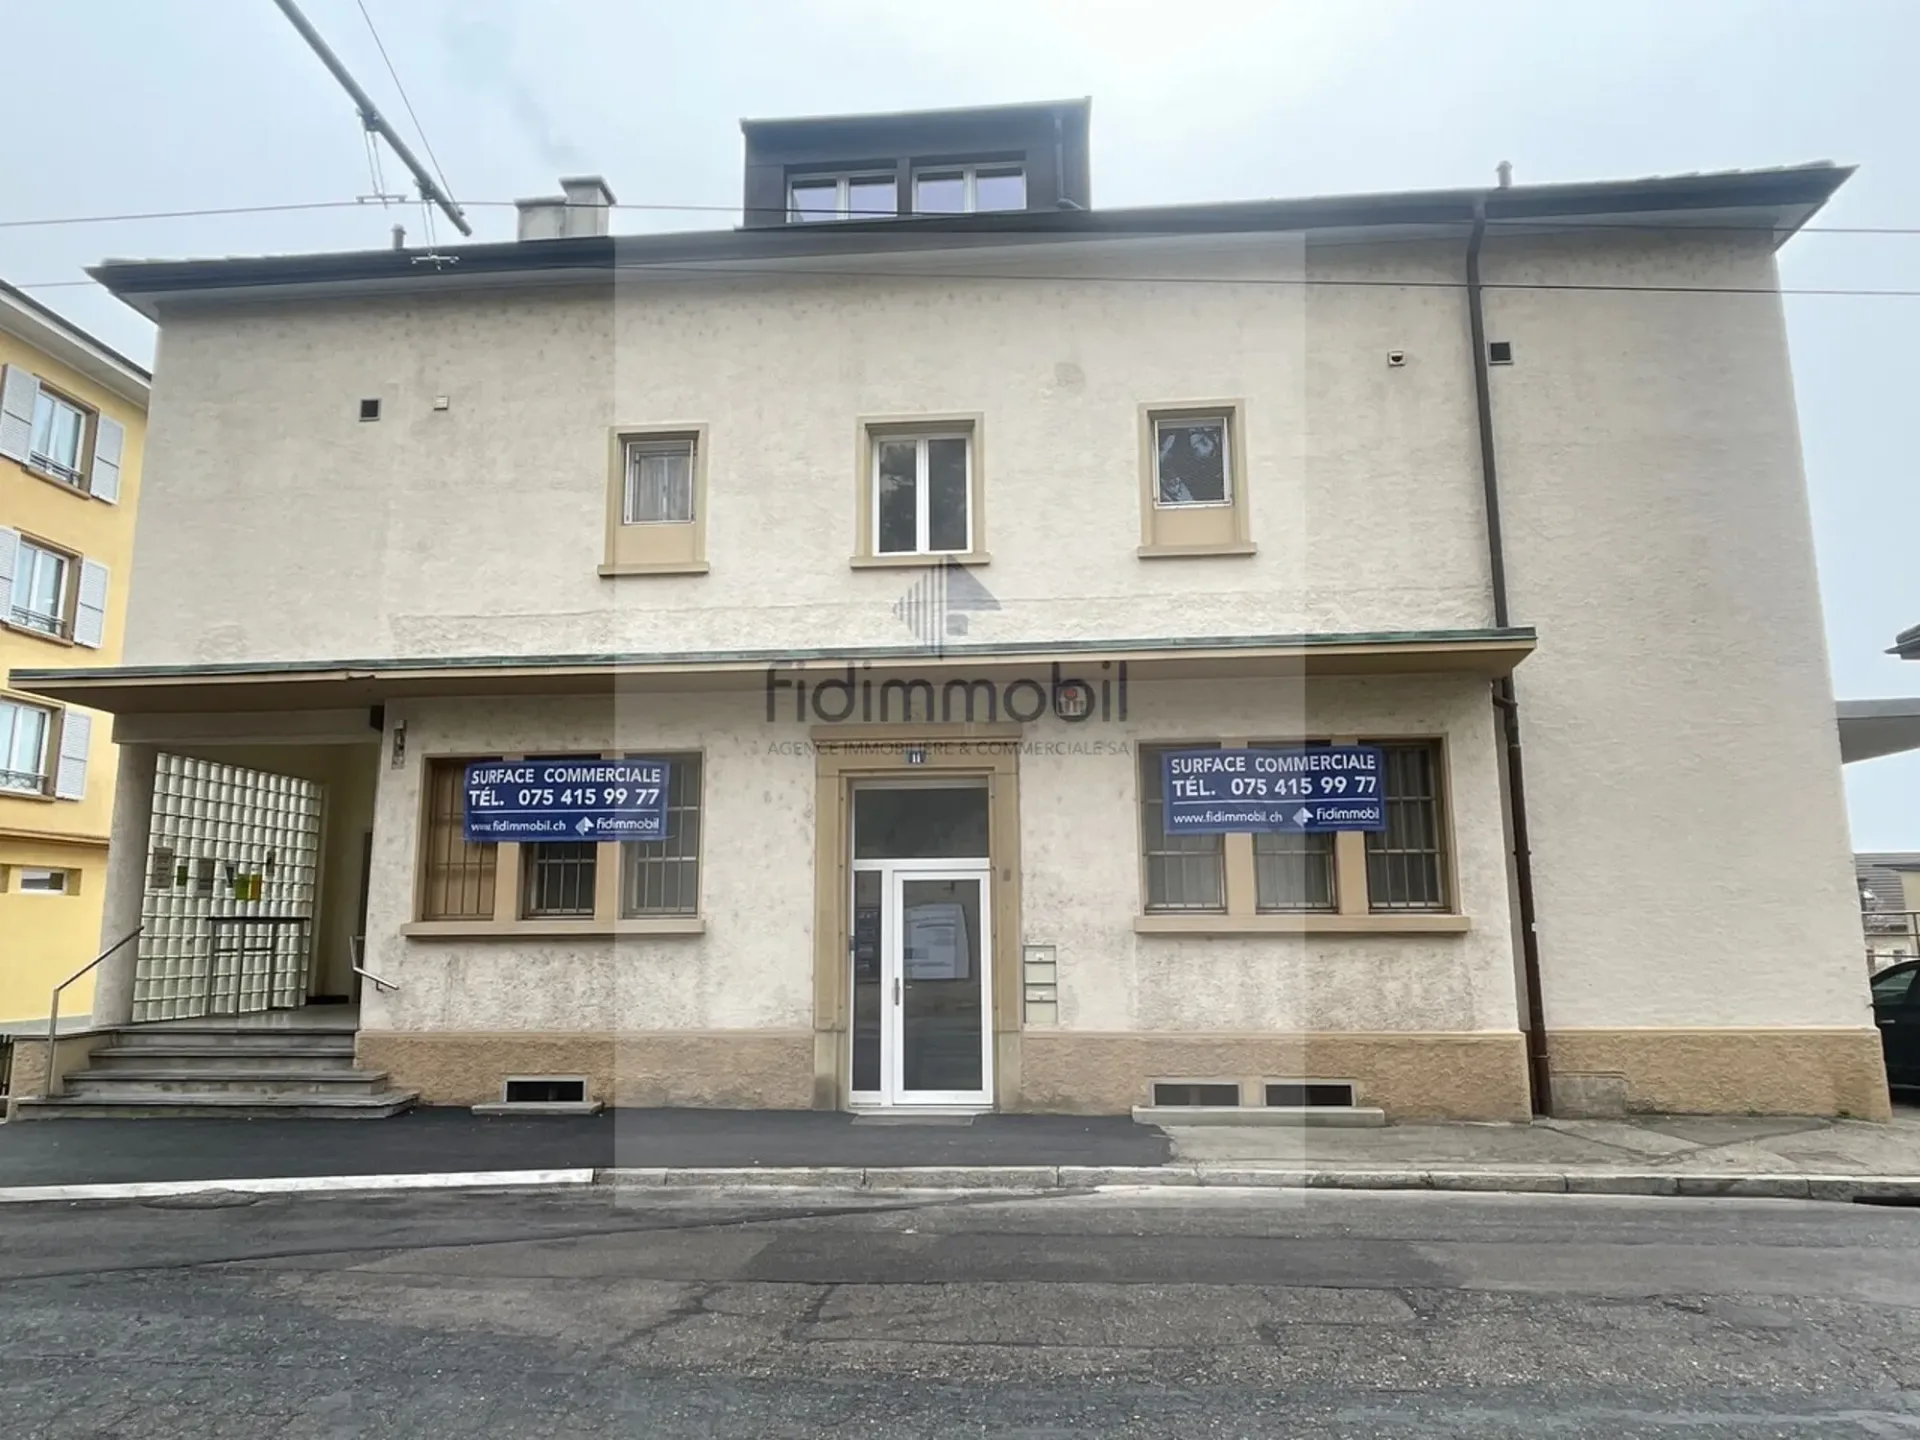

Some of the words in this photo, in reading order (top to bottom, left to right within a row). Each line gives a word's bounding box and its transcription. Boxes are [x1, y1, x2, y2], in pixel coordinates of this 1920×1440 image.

[1171, 756, 1246, 774] SURFACE
[1255, 754, 1376, 773] COMMERCIALE
[471, 768, 534, 785] SURFACE
[544, 767, 661, 783] COMMERCIALE
[1172, 776, 1216, 797] TÉL.
[1231, 778, 1267, 796] 075
[1274, 777, 1313, 795] 415
[1320, 776, 1347, 794] 99
[1354, 776, 1377, 793] 77
[469, 787, 505, 806] TÉL.
[518, 789, 554, 806] 075
[560, 789, 596, 805] 415
[603, 789, 628, 805] 99
[635, 788, 660, 805] 77
[1173, 810, 1283, 824] www.fidimmobil.ch
[1316, 806, 1380, 820] fidimmobil
[470, 819, 567, 833] www.fidimmobil.ch
[596, 817, 660, 829] fidimmobil
